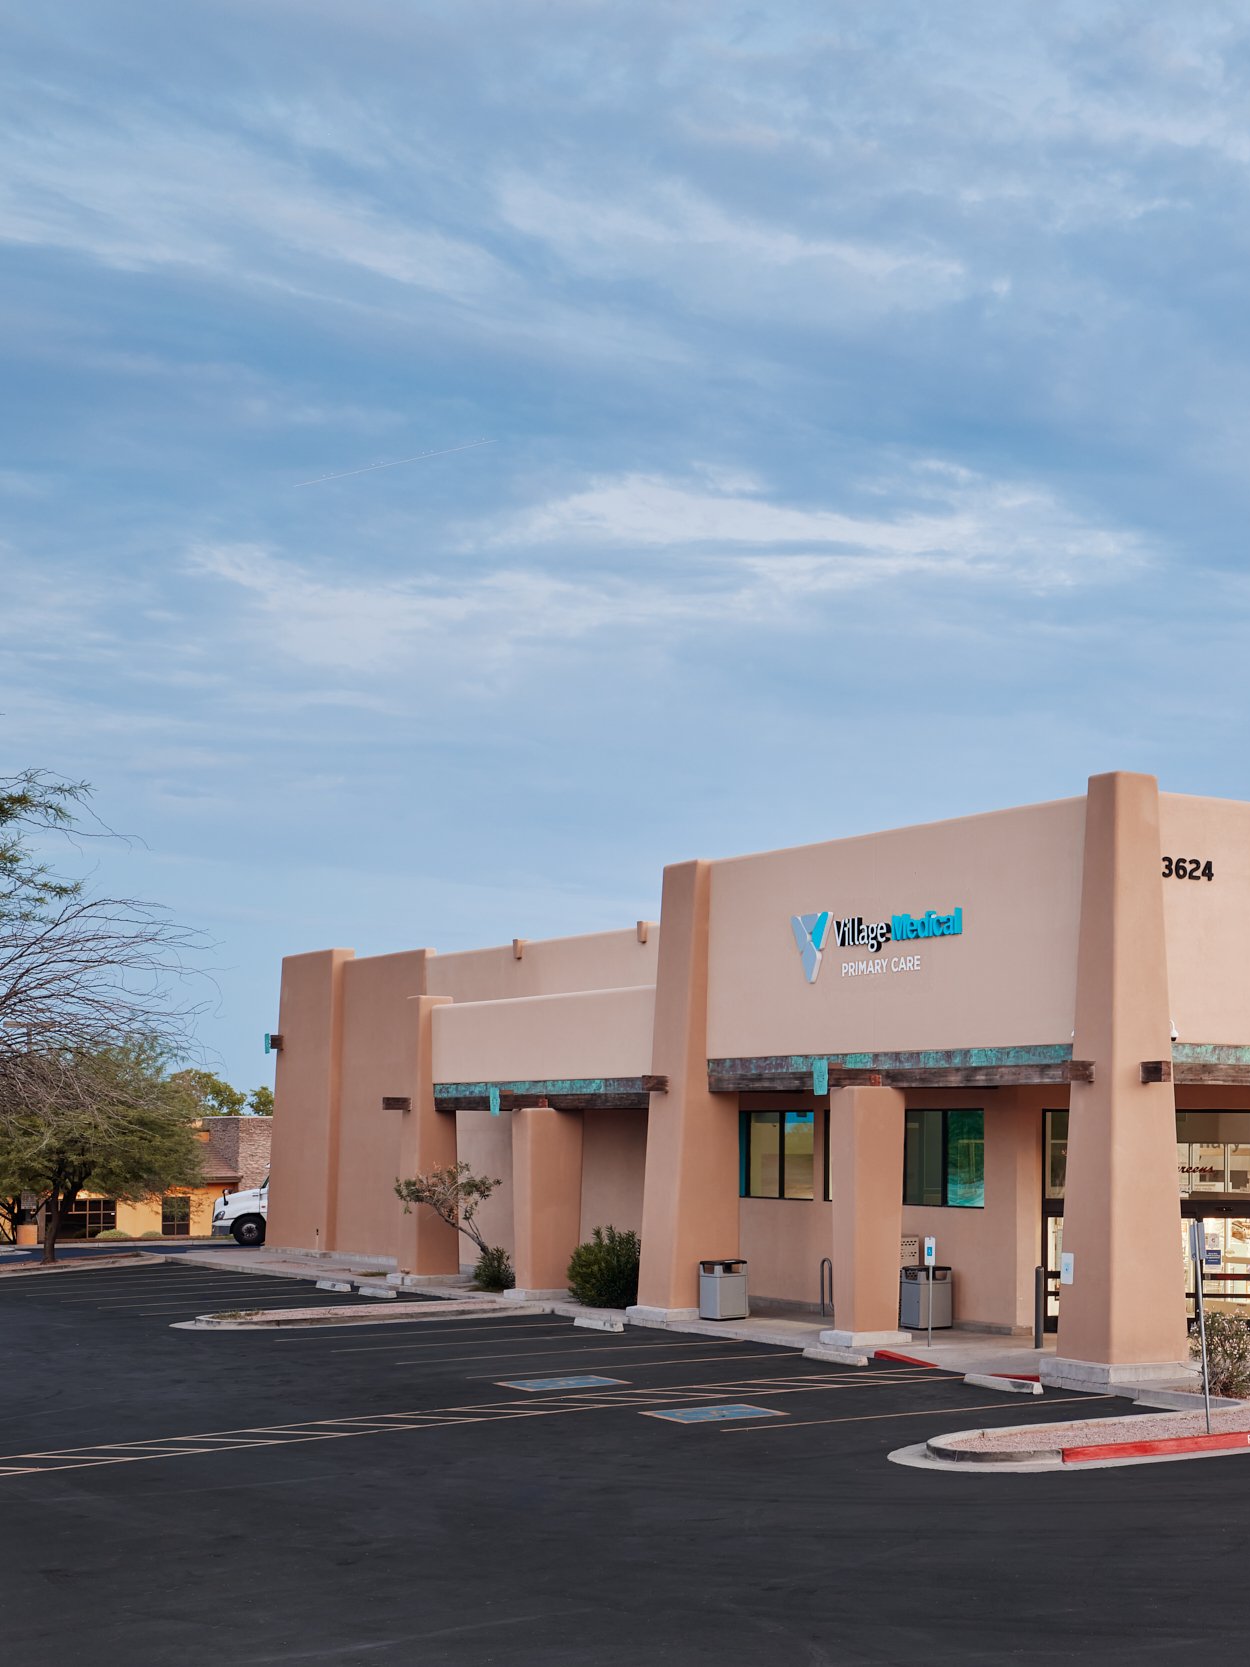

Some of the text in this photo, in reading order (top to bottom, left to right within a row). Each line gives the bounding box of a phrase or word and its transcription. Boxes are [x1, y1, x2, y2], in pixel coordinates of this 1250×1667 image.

[1162, 856, 1214, 882] 3624
[841, 955, 921, 977] PRIMARY CARE
[1177, 1165, 1216, 1174] reens
